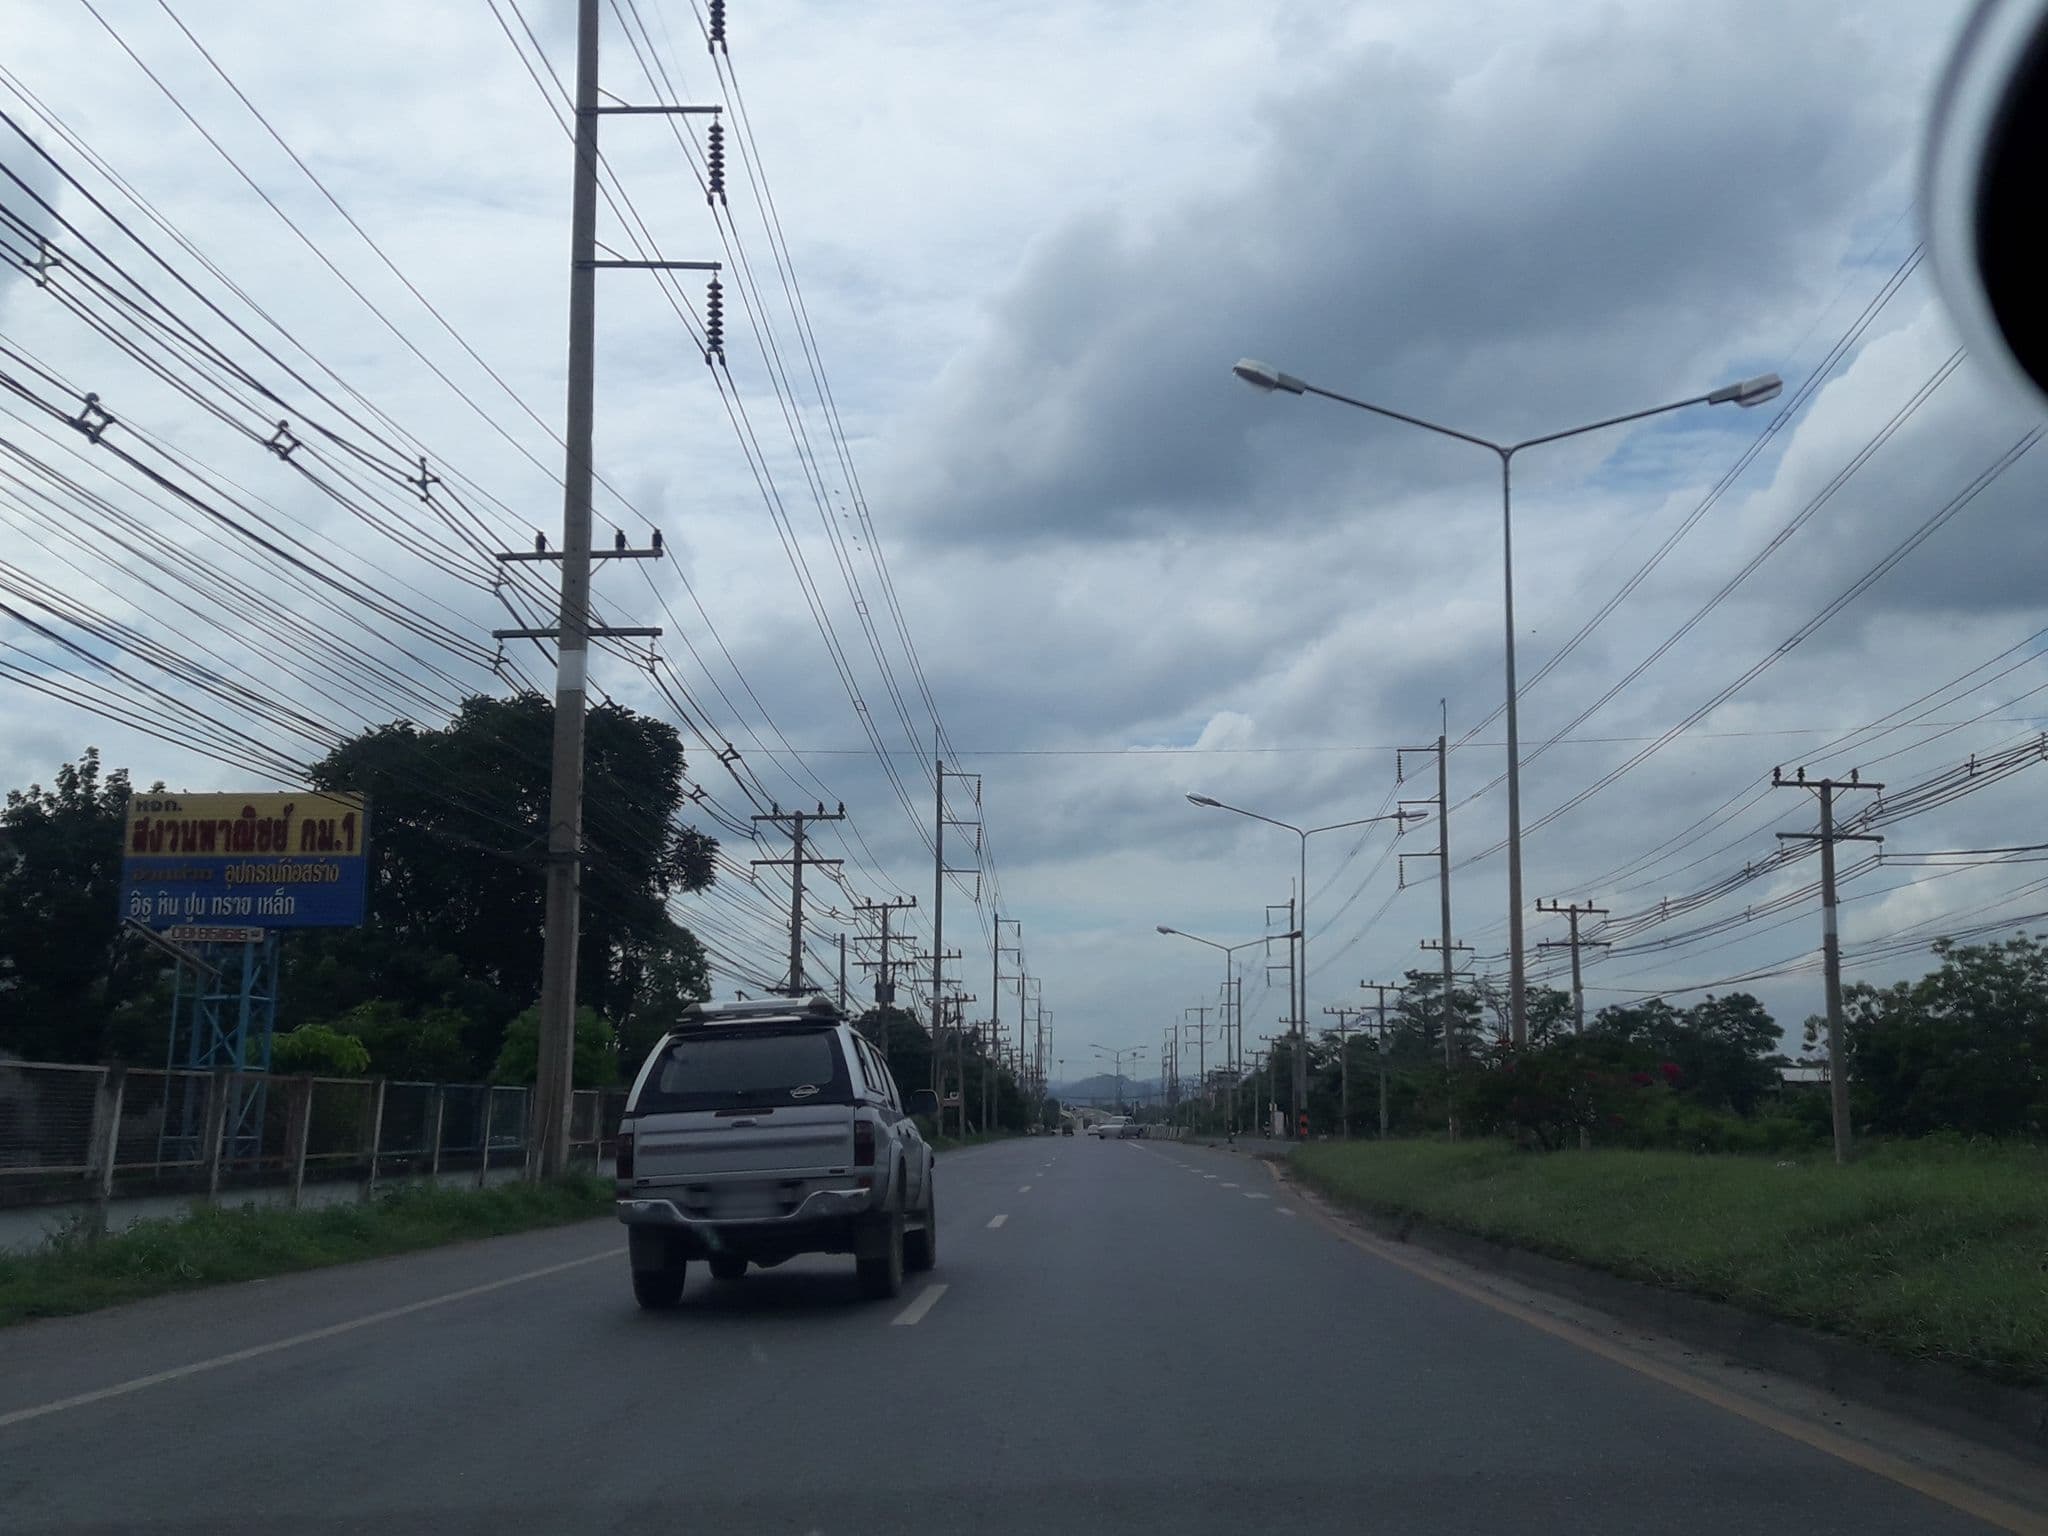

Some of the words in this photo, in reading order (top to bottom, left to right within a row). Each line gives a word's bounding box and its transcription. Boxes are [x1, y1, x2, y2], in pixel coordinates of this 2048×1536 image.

[225, 857, 340, 889] อุปกรณ์ก่อสร้าง
[130, 889, 152, 923] อิฐ
[158, 890, 178, 915] หิน
[184, 891, 205, 922] ปูน
[211, 896, 251, 916] ทราย
[257, 887, 295, 915] เหล็ก
